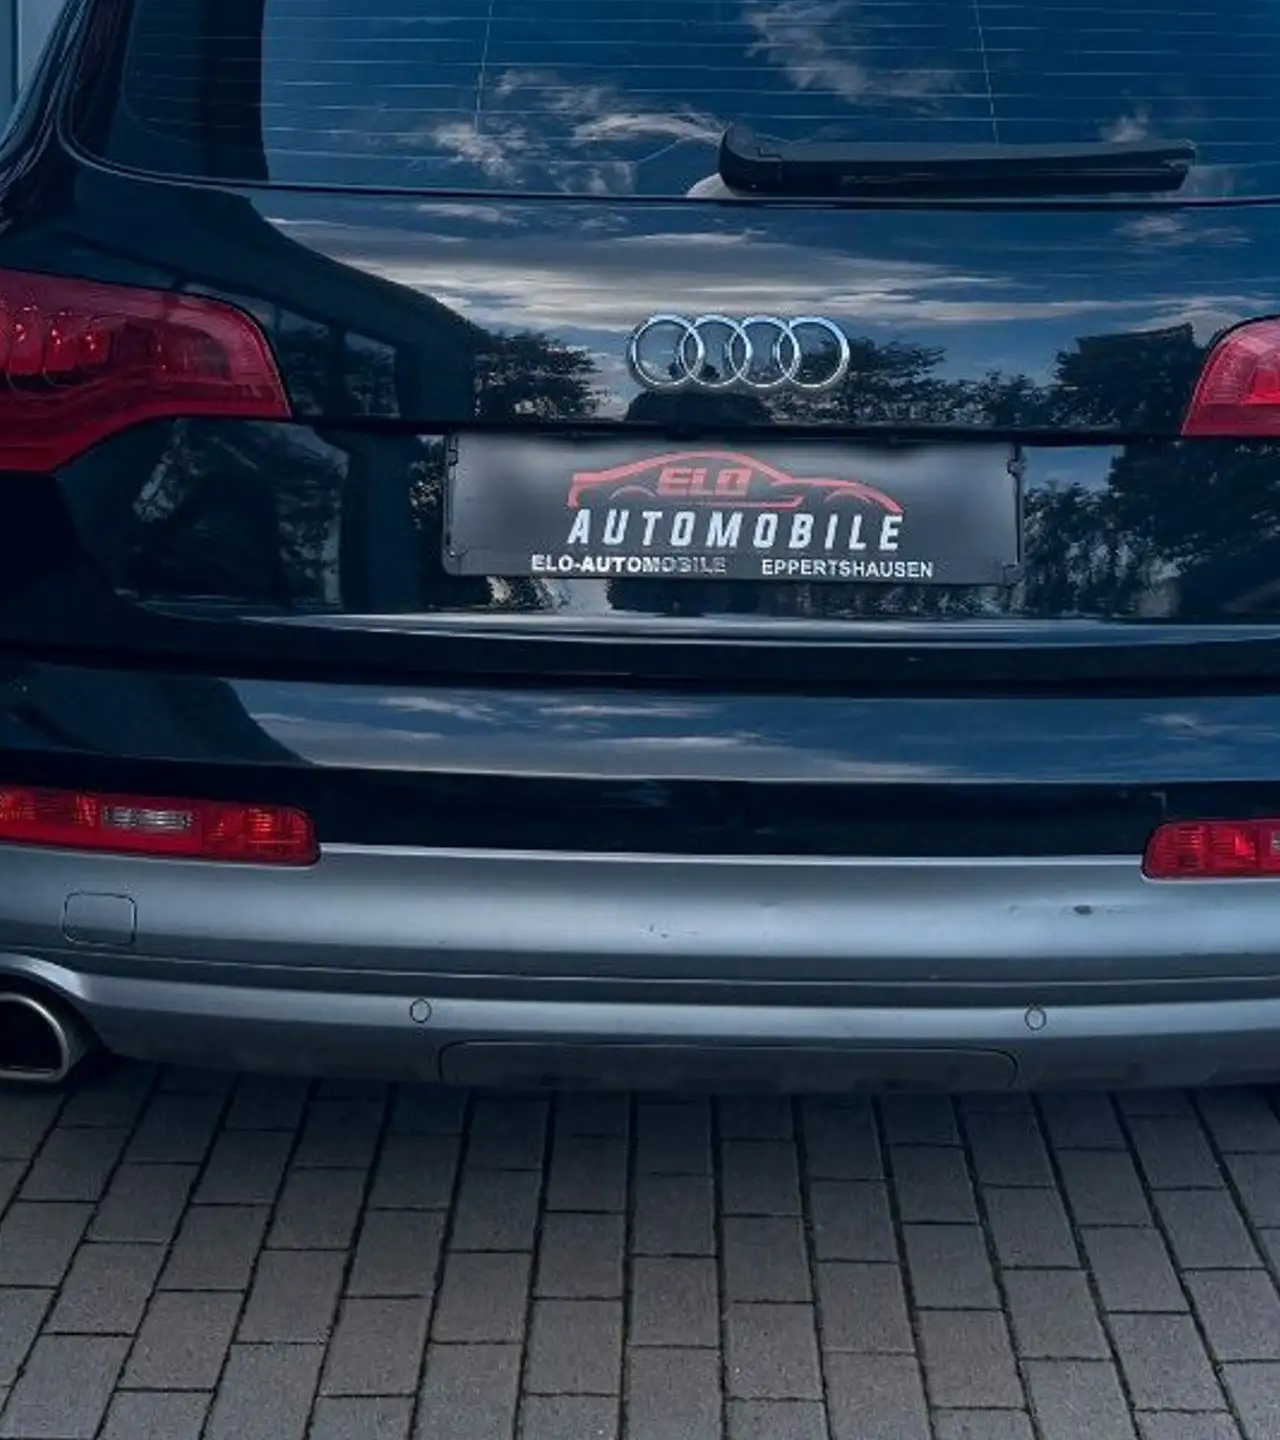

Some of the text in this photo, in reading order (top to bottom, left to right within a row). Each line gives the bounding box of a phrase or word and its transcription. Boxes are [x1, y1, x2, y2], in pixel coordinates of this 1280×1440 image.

[656, 468, 752, 496] ELO
[567, 509, 904, 550] AUTOMOBILE
[531, 554, 933, 578] ELO-AUTOMOBILE EPPERTSHAUSEN
